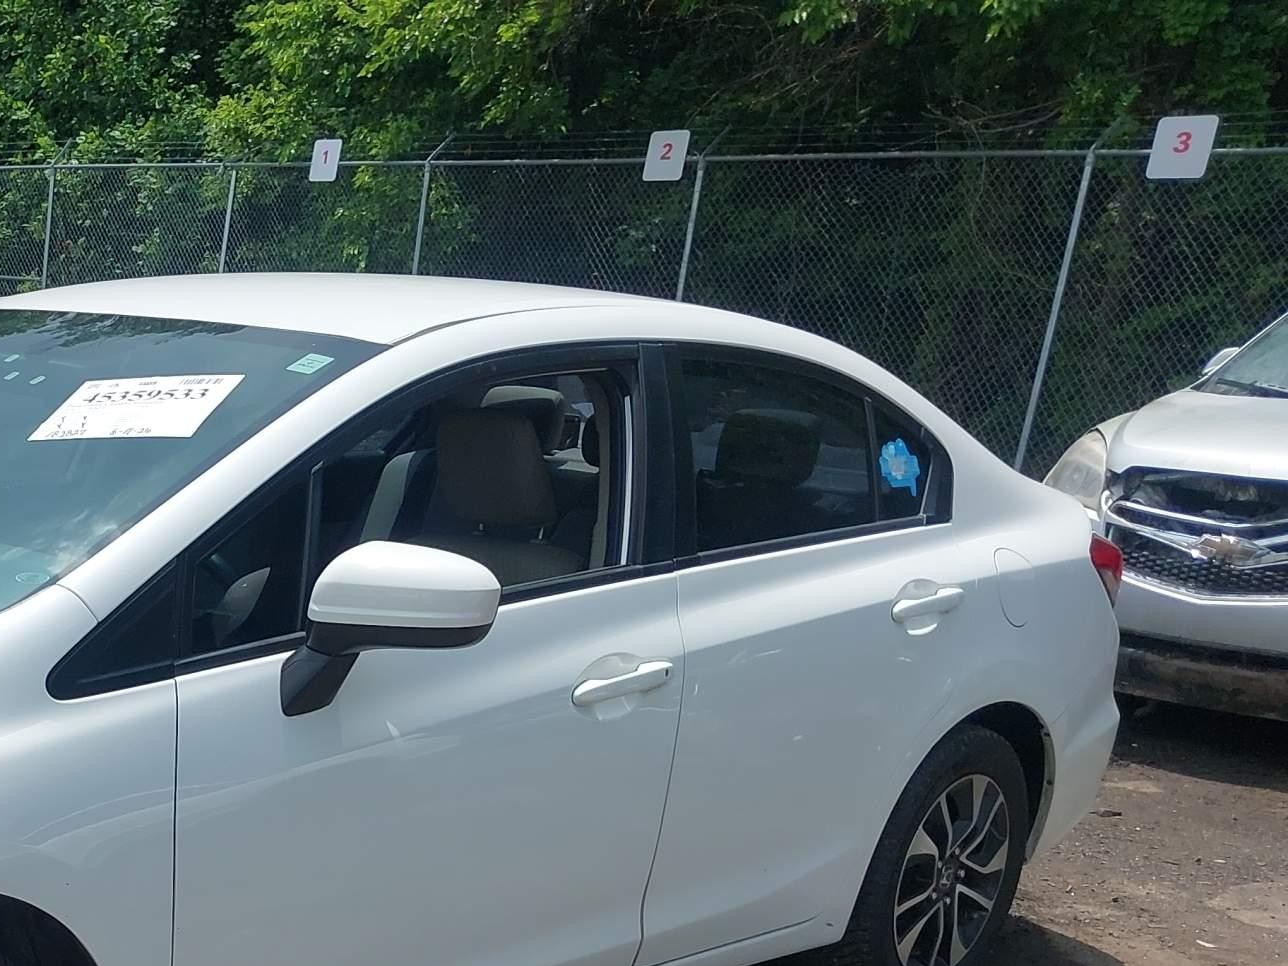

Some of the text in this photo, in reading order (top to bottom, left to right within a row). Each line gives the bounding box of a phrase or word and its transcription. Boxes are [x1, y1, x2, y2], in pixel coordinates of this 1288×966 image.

[1173, 131, 1192, 154] 3
[322, 150, 329, 165] 1
[660, 143, 673, 161] 2
[83, 388, 210, 404] 45359533
